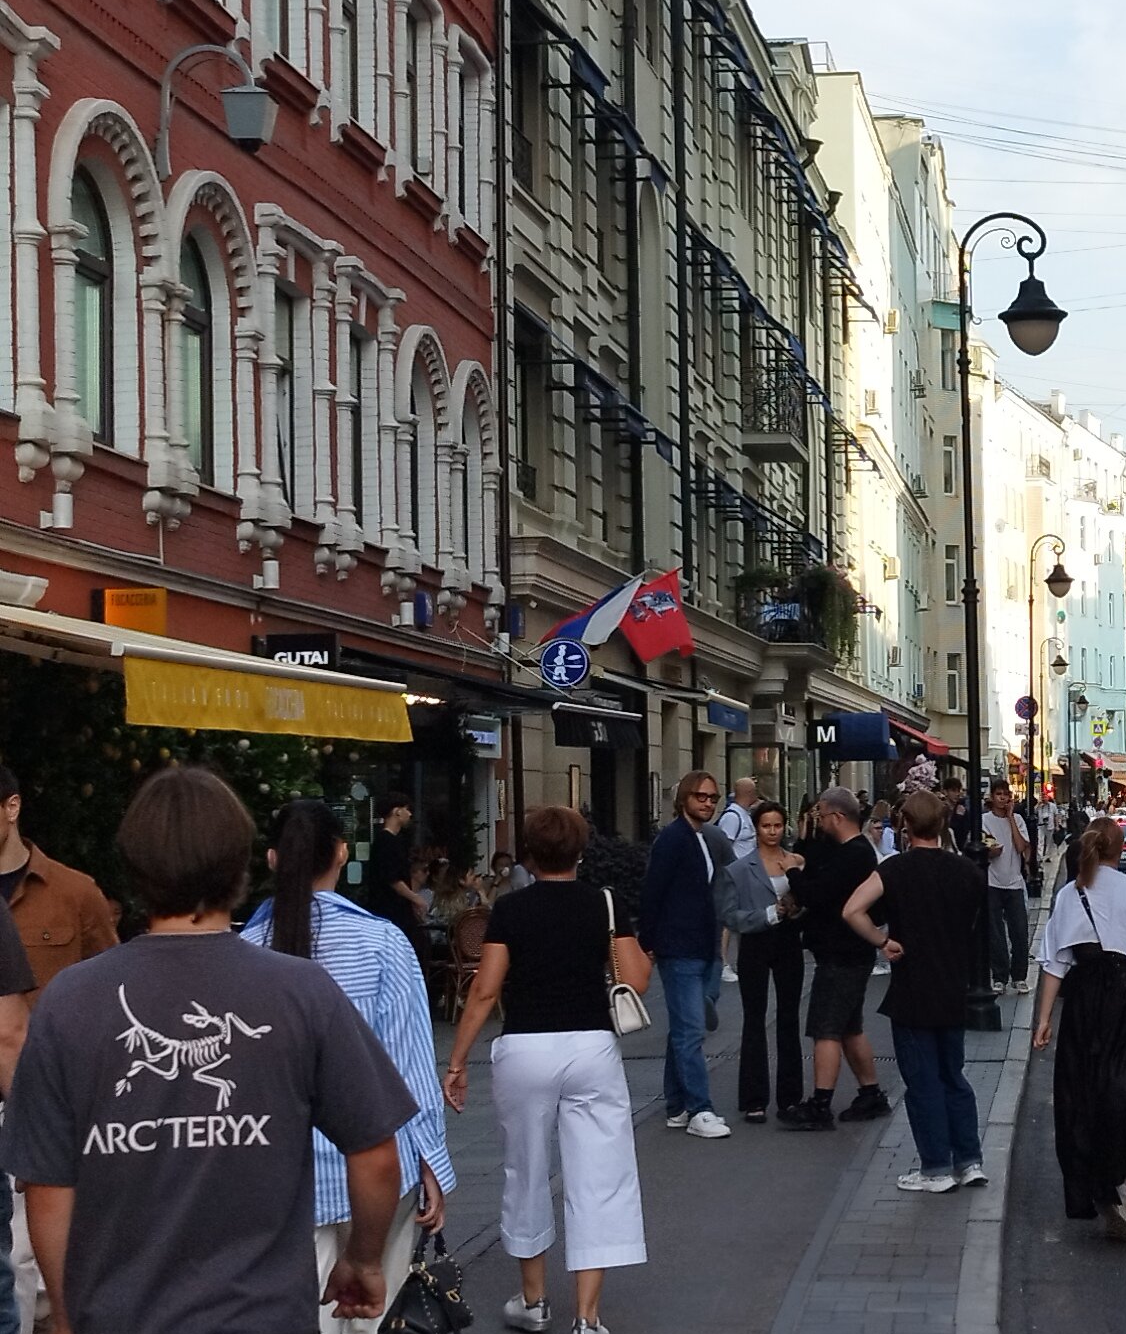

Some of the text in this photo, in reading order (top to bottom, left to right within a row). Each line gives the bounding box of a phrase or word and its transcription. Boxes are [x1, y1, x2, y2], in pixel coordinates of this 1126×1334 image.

[274, 650, 329, 665] GUTAI
[816, 725, 836, 743] M
[83, 1115, 271, 1155] ARC'TERYX
